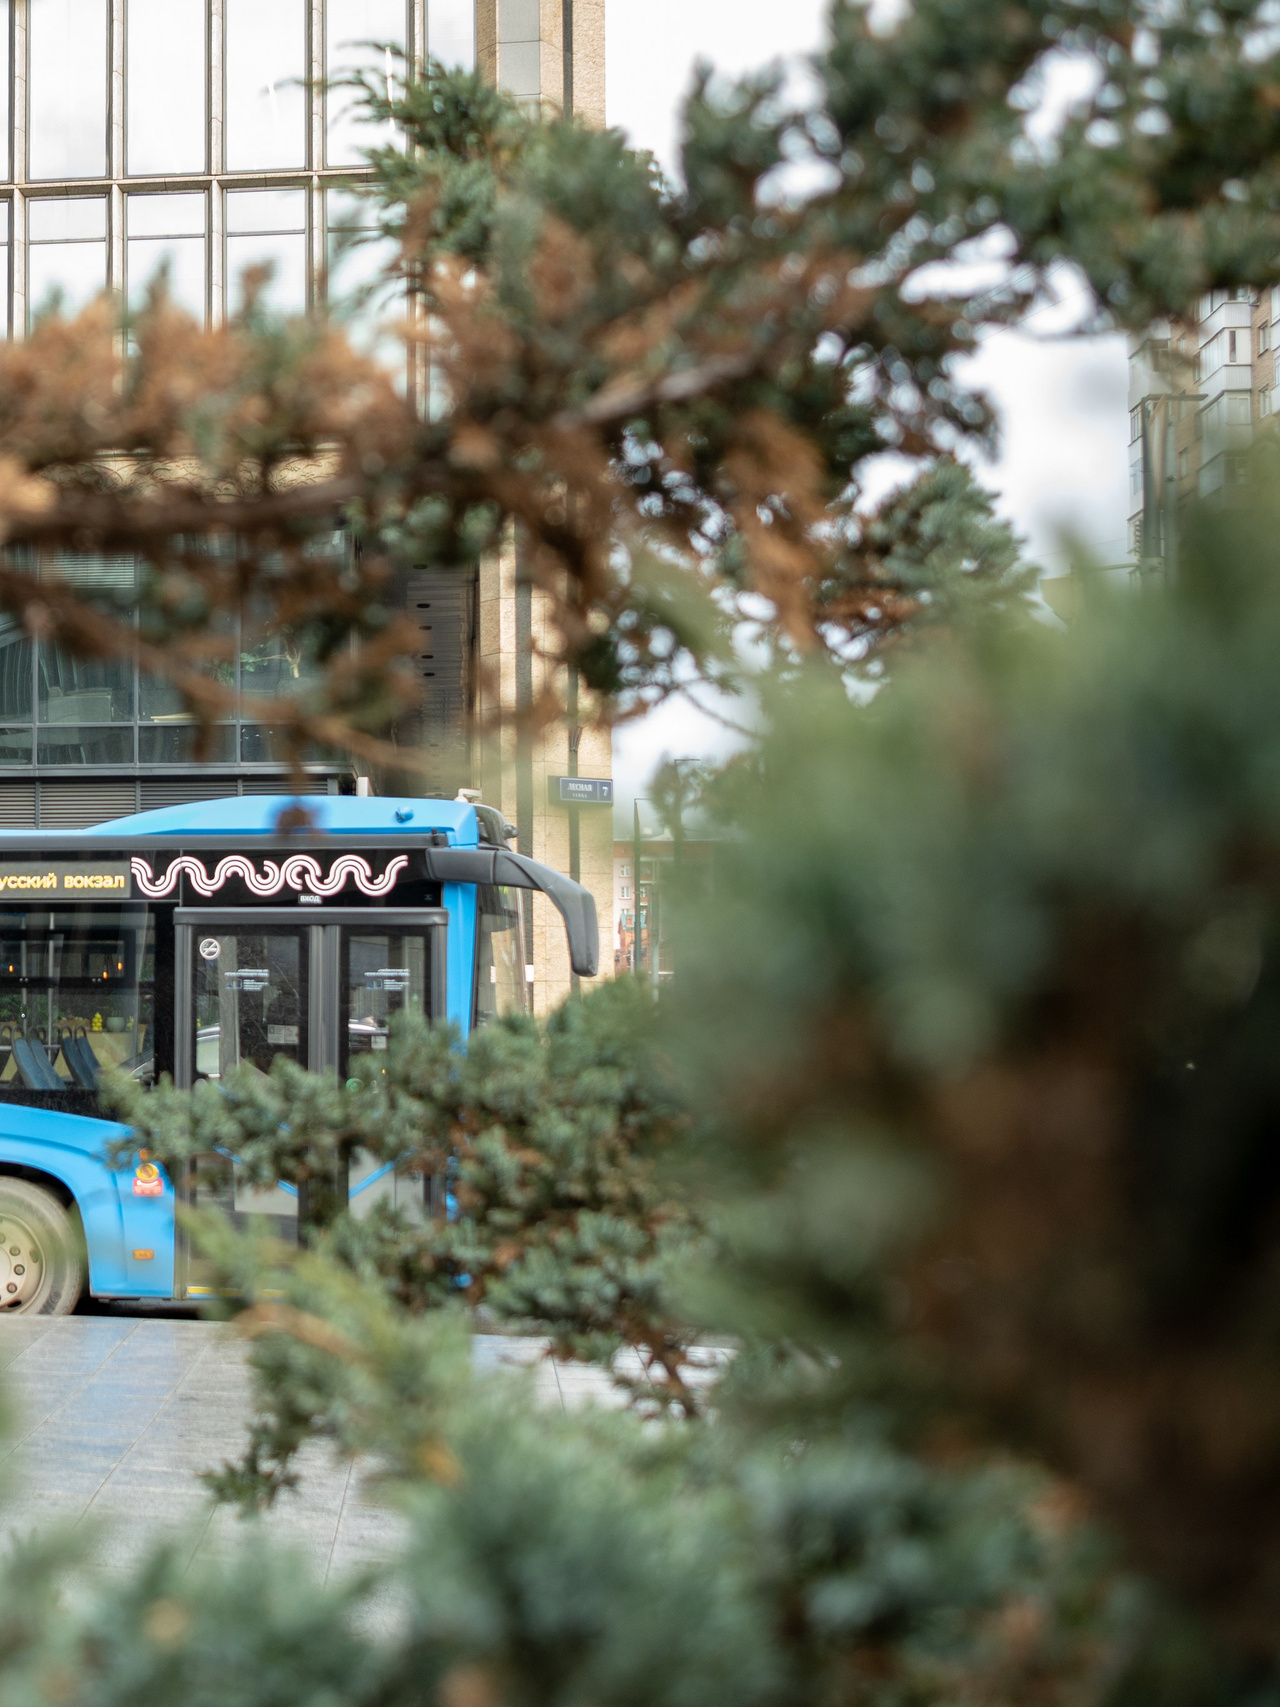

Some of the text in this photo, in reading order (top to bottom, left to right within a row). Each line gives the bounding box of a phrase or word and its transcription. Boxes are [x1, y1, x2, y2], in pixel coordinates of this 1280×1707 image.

[567, 783, 593, 792] ЛЕСНАЯ
[602, 786, 609, 797] 7
[64, 874, 125, 889] вокзал
[300, 894, 322, 904] ВХОД
